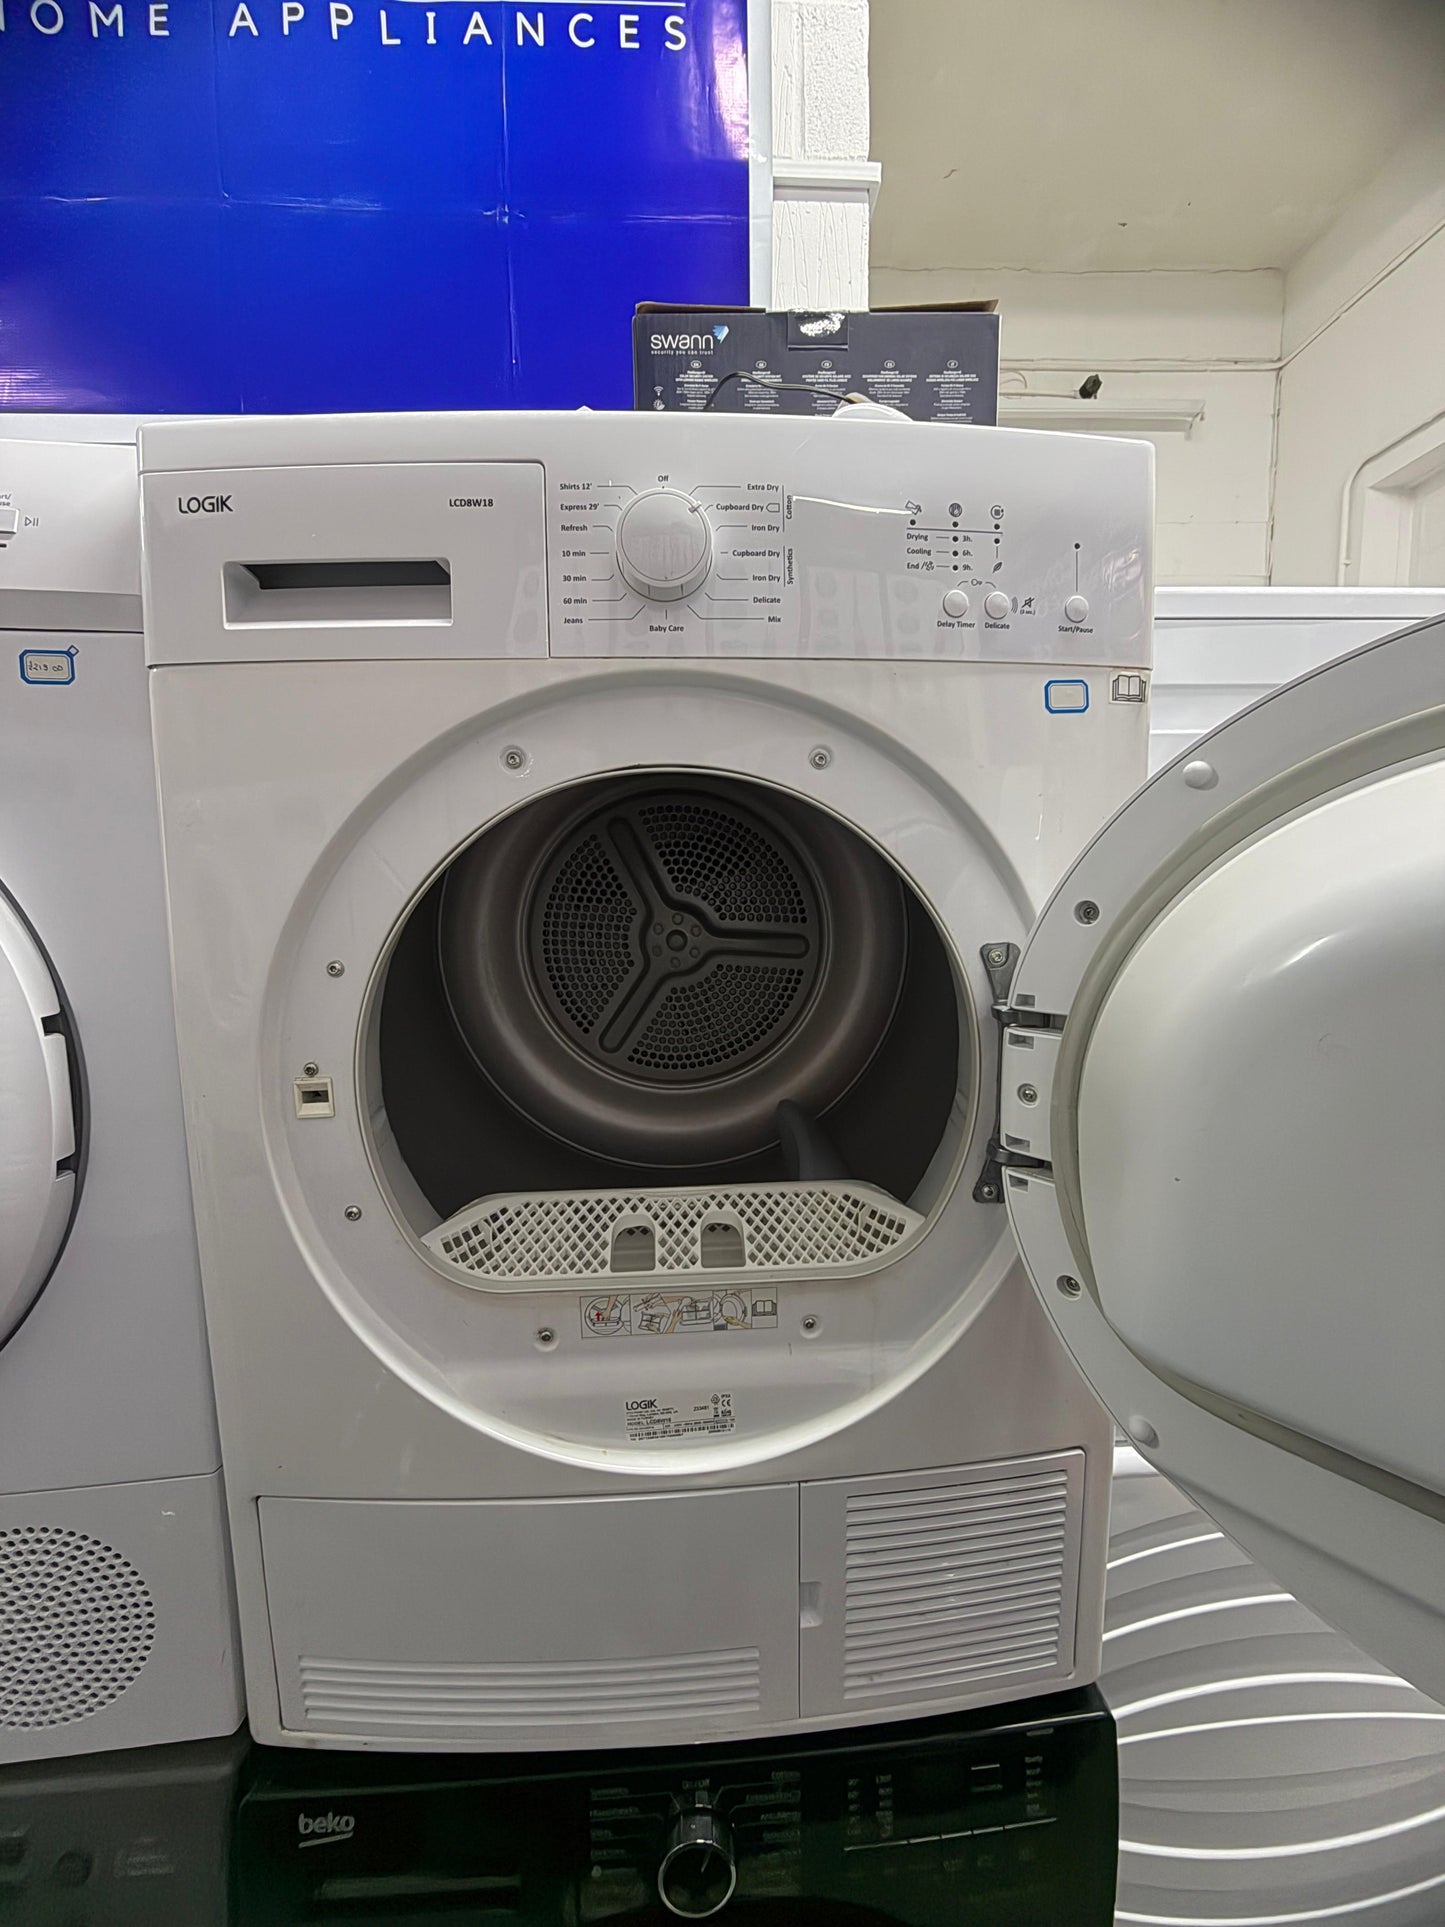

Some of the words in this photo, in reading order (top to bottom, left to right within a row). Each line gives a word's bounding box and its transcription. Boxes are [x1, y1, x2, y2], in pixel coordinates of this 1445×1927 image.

[0, 0, 169, 38] OME
[229, 1, 687, 51] APPLIANCES
[650, 334, 714, 349] swann
[559, 483, 580, 491] Shirts
[747, 483, 763, 491] Extra
[765, 483, 780, 493] Dry
[178, 495, 233, 514] LOGIK
[448, 498, 494, 508] LCD8W18
[560, 503, 586, 512] Express
[716, 503, 751, 512] Cupboard
[752, 503, 764, 513] Dry
[785, 495, 794, 520] Cotton
[561, 524, 588, 532] Refresh
[751, 524, 765, 532] Iron
[767, 524, 780, 534] Dry
[906, 533, 929, 542] Drying
[732, 549, 766, 558] Cupboard
[767, 549, 780, 559] Dry
[906, 547, 932, 556] Cooling
[786, 548, 795, 585] Synthetics
[906, 562, 920, 570] End
[752, 574, 767, 582] Iron
[767, 574, 781, 584] Dry
[563, 597, 572, 605] 60
[572, 597, 588, 605] min
[753, 596, 781, 604] Delicate
[563, 616, 583, 625] Jeans
[937, 620, 955, 630] Delay
[956, 621, 976, 629] Timer
[649, 625, 667, 633] Baby
[984, 622, 1010, 630] Delicate
[1058, 625, 1094, 635] Start/Pause
[626, 1399, 658, 1411] LOGIK
[298, 1812, 355, 1835] beko
